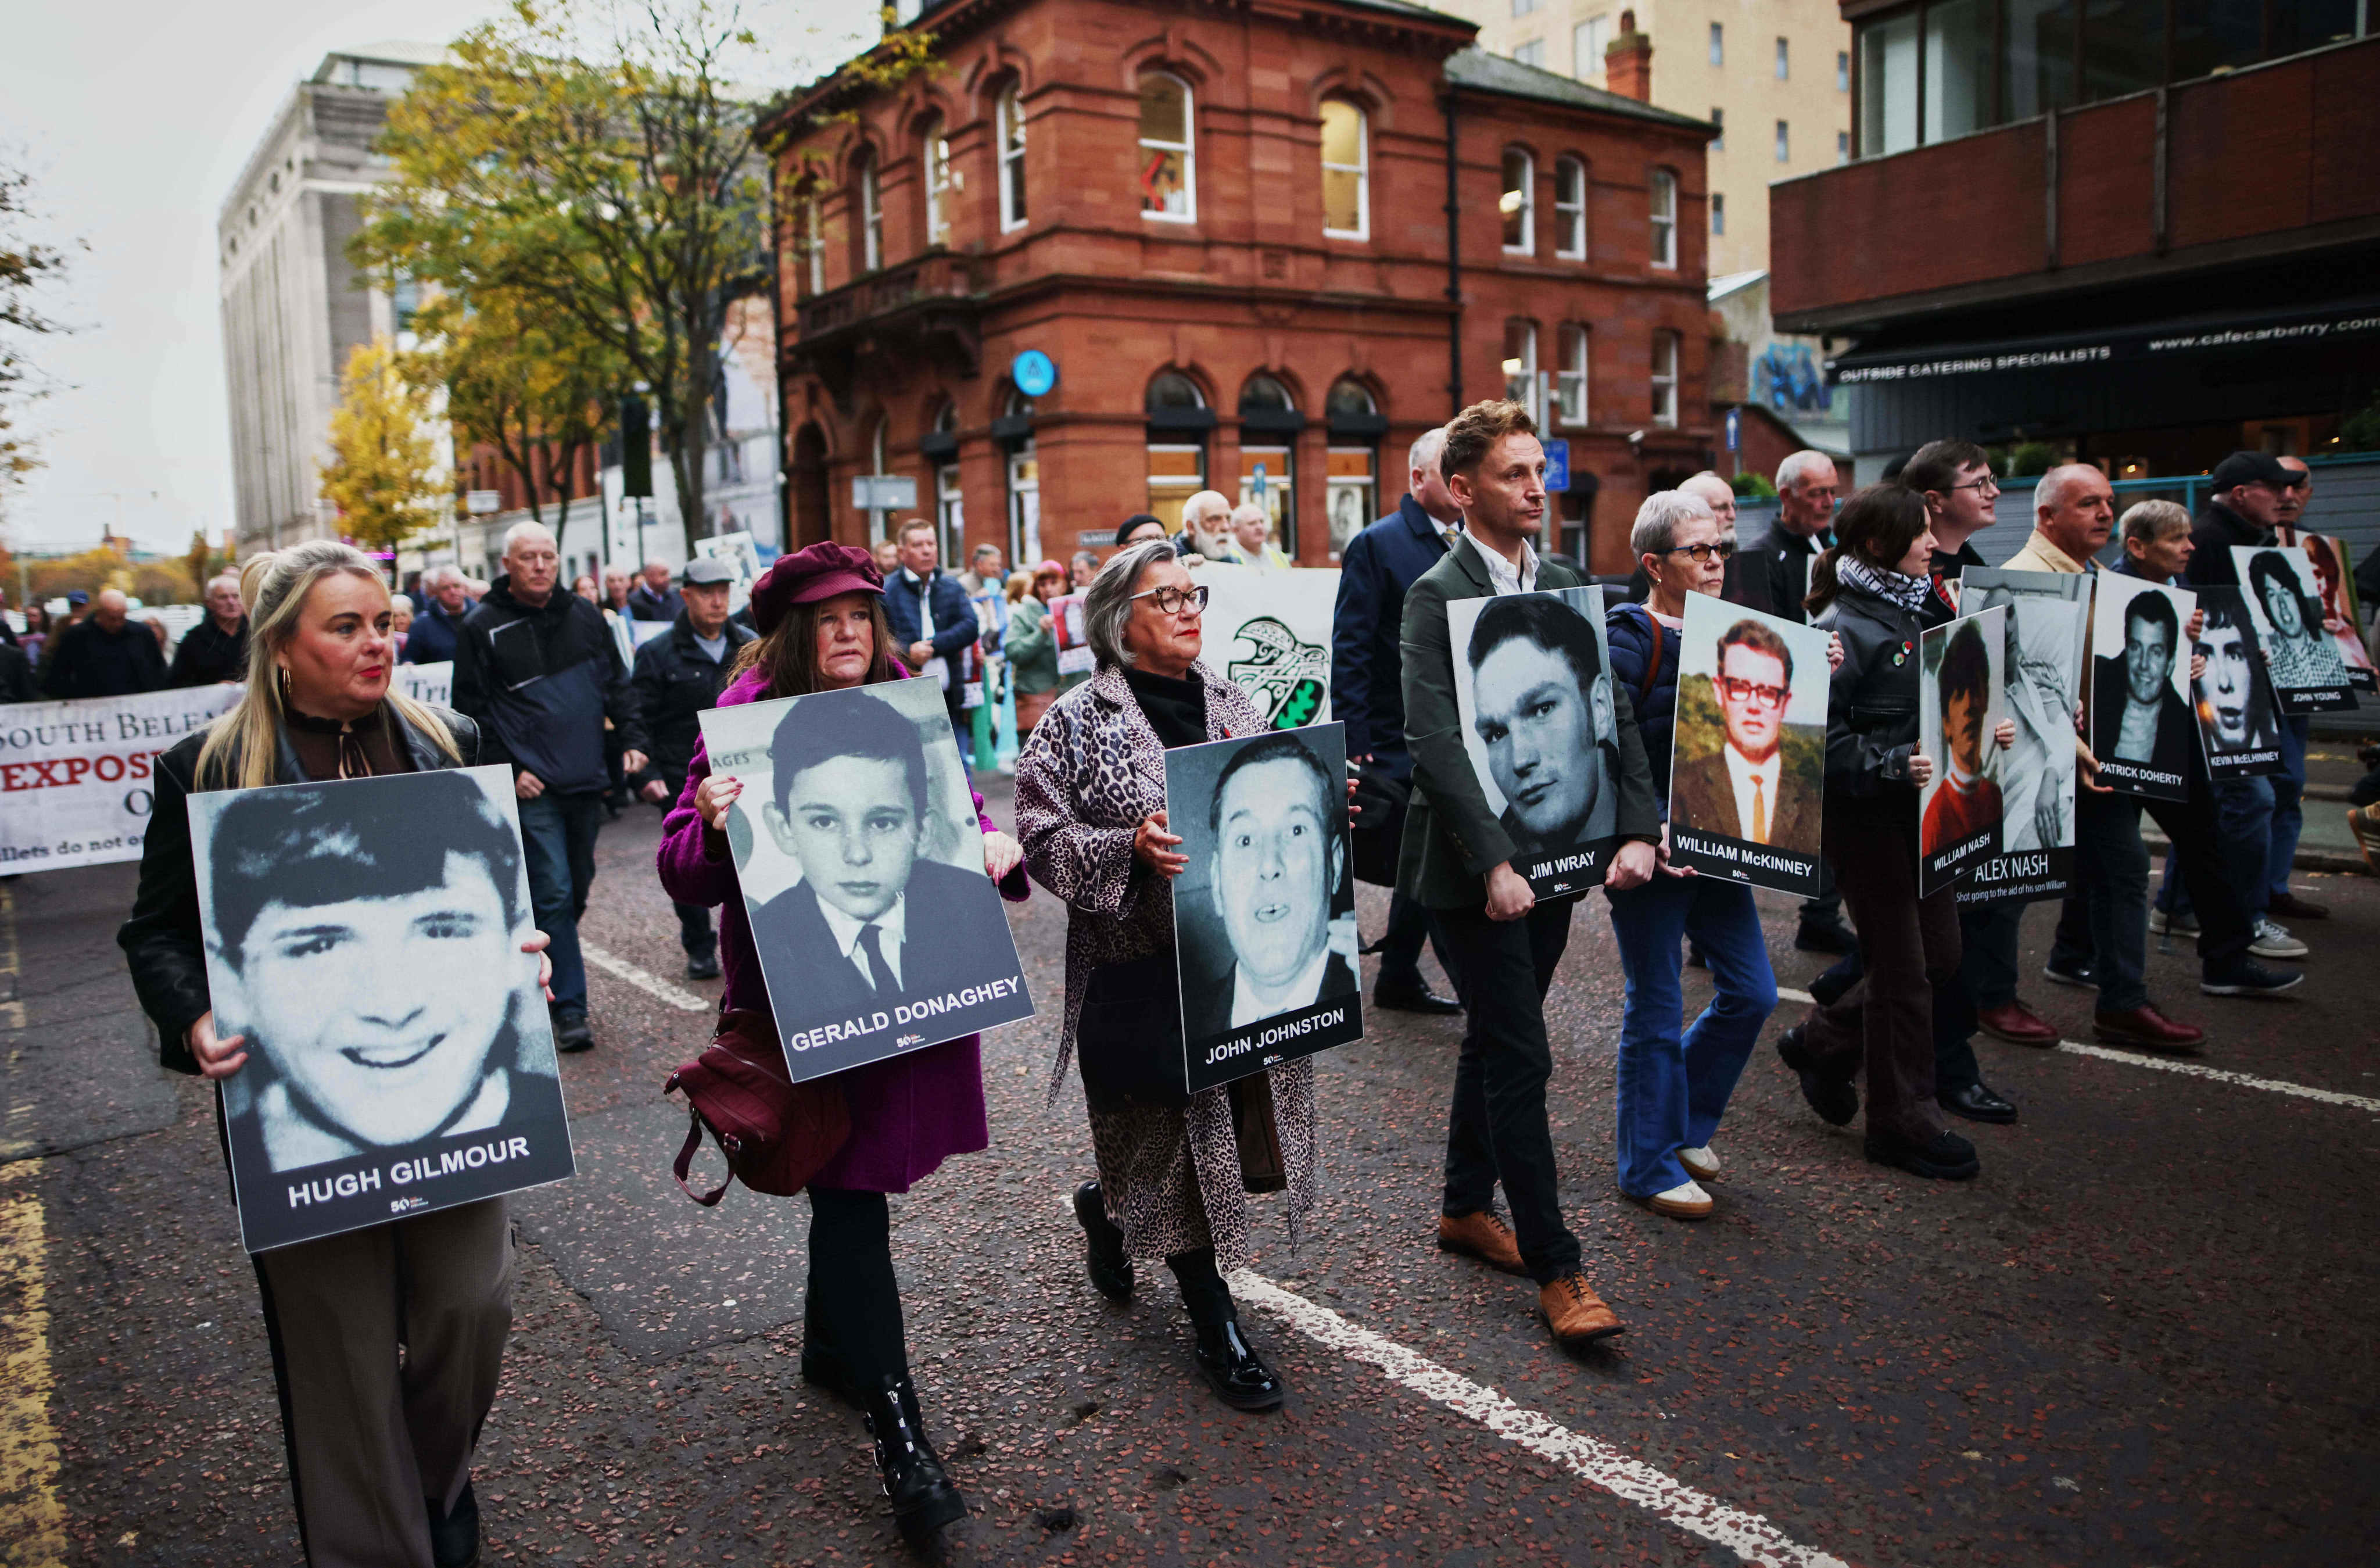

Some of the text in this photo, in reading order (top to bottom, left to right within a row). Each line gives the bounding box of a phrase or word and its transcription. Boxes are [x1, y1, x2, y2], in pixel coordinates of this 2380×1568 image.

[1840, 345, 2110, 382] OUTSIDE CATERING SPECIALISTS
[2293, 691, 2341, 702] JOHN YOUNG
[1, 748, 164, 792] EXPOS
[2099, 761, 2183, 786] PATRICK DOHERTY
[2211, 751, 2279, 767] KEVIN McELHINNEY
[0, 846, 50, 862] llets
[57, 840, 82, 855] do
[89, 835, 121, 852] not
[1676, 835, 1812, 878] WILLIAM McKINNEY
[1934, 832, 1990, 872] WILLIAM NASH
[1530, 851, 1595, 880] JIM WRAY
[1974, 854, 2048, 882] ALEX NASH
[1956, 880, 2067, 903] Shot going to the aid of his son William
[791, 976, 1019, 1052] GERALD DONAGHEY
[1205, 1008, 1344, 1065] JOHN JOHNSTON
[288, 1136, 530, 1208] HUGH GILMOUR
